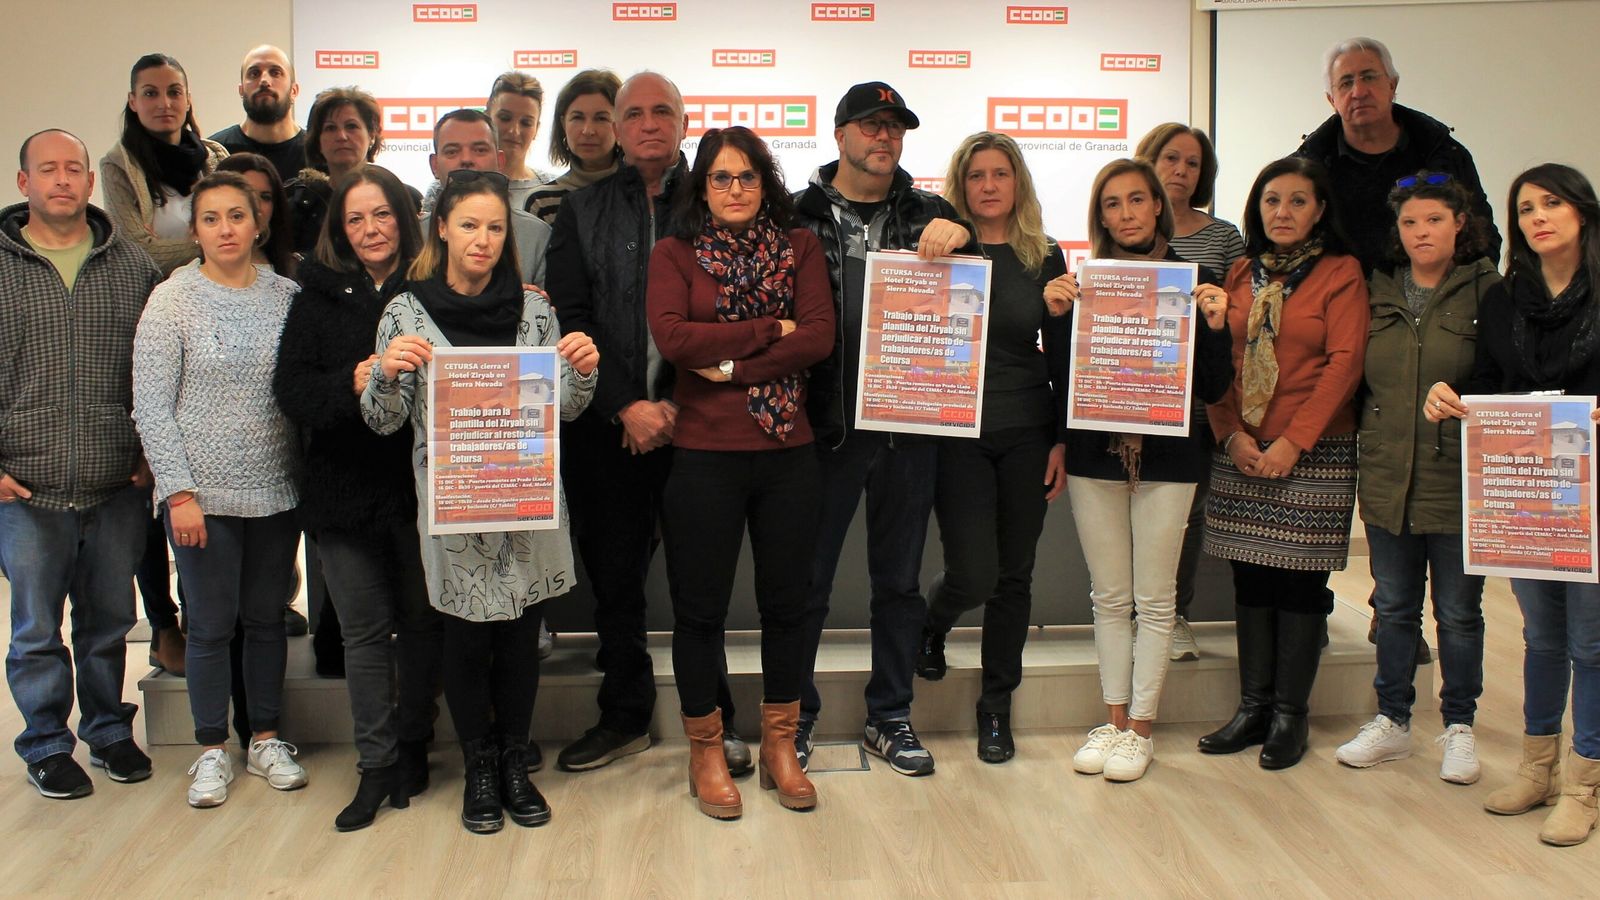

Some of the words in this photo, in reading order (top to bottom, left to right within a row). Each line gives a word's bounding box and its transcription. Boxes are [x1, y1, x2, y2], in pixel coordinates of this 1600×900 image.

[772, 140, 817, 149] Granada
[1069, 142, 1082, 151] de
[1085, 141, 1128, 152] Granada
[905, 278, 927, 286] Ziryab
[883, 310, 912, 320] Trabajo
[913, 314, 931, 322] para
[933, 314, 940, 322] la
[1092, 314, 1121, 323] Trabajo
[882, 321, 915, 332] plantilla
[915, 324, 928, 332] del
[929, 325, 953, 334] Ziryab
[954, 327, 966, 335] sin
[1092, 324, 1123, 334] plantilla
[1124, 326, 1136, 334] del
[1137, 327, 1161, 336] Ziryab
[881, 333, 922, 343] perjudicar
[932, 337, 952, 345] resto
[953, 338, 963, 346] de
[1091, 336, 1130, 345] perjudicar
[1161, 339, 1171, 347] de
[880, 344, 943, 356] trabajadores/as
[944, 348, 954, 356] de
[1090, 346, 1151, 357] trabajadores/as
[880, 355, 910, 364] Cetursa
[1090, 356, 1119, 365] Cetursa
[450, 407, 481, 417] Trabajo
[482, 408, 500, 416] para
[503, 407, 510, 415] la
[450, 419, 484, 428] plantilla
[485, 419, 498, 427] del
[500, 418, 524, 427] Ziryab
[526, 418, 538, 426] sin
[450, 431, 493, 440] perjudicar
[494, 430, 501, 438] al
[525, 430, 535, 438] de
[450, 441, 515, 452] trabajadores/as
[517, 441, 527, 449] de
[450, 454, 482, 463] Cetursa
[1482, 454, 1513, 463] Trabajo
[1515, 456, 1533, 464] para
[1483, 465, 1516, 475] plantilla
[1518, 467, 1531, 475] del
[1533, 467, 1558, 476] Ziryab
[1560, 468, 1573, 476] sin
[1483, 477, 1525, 487] perjudicar
[1527, 478, 1534, 486] al
[1560, 480, 1570, 488] de
[1483, 488, 1549, 499] trabajadores/as
[1551, 491, 1561, 499] de
[1483, 499, 1515, 508] Cetursa
